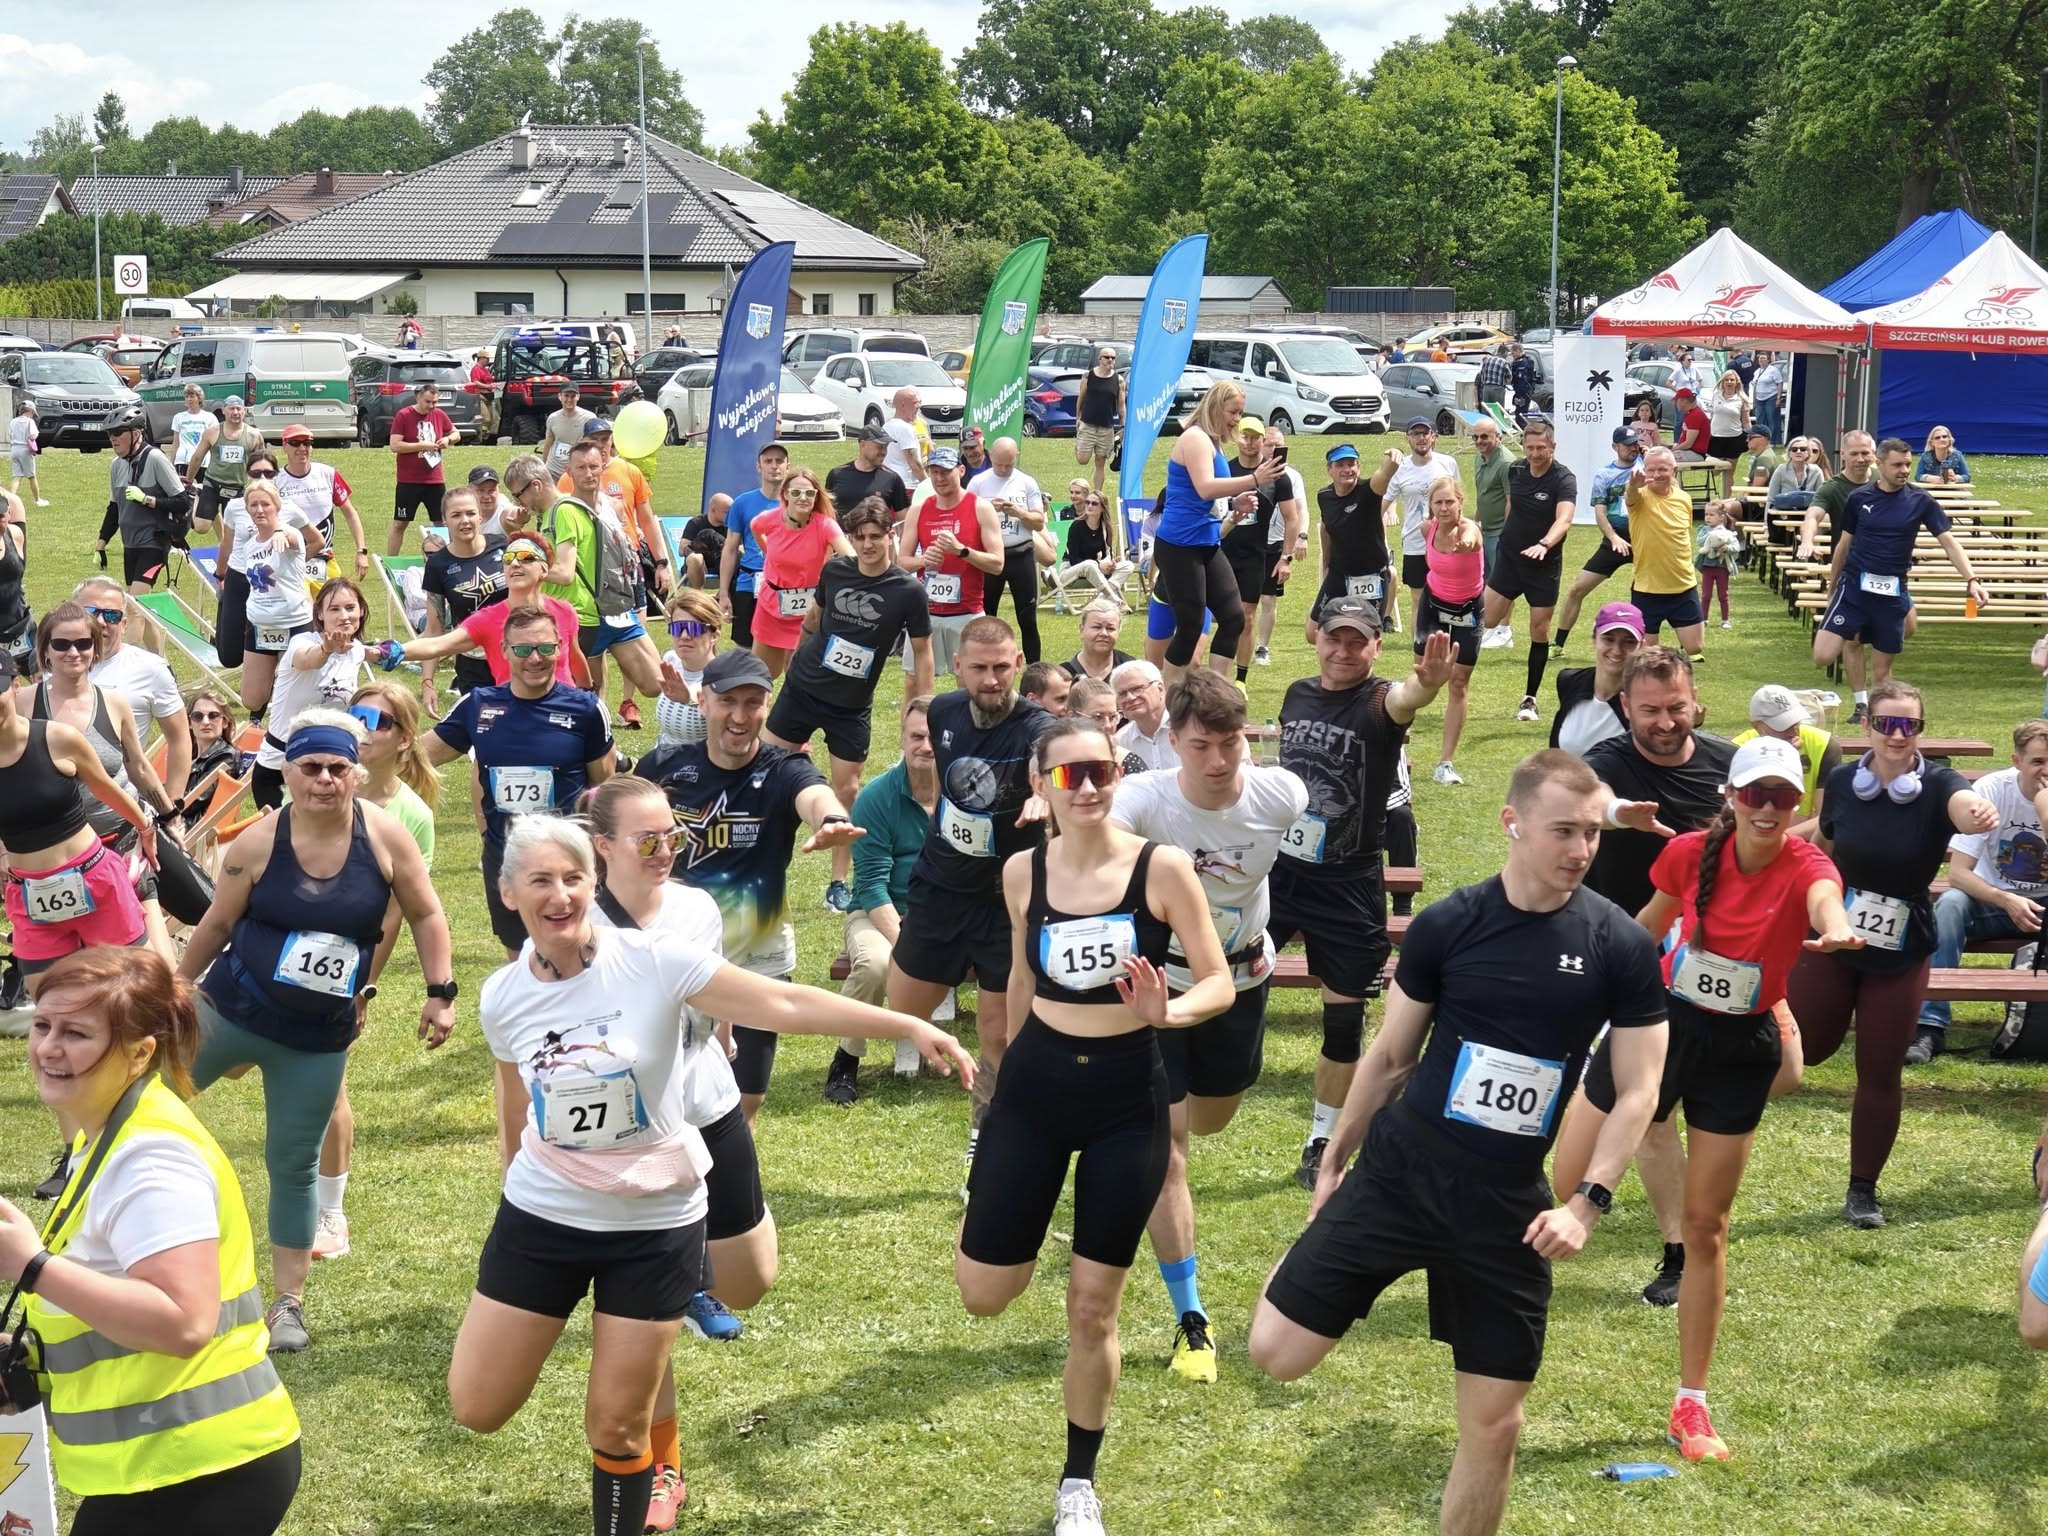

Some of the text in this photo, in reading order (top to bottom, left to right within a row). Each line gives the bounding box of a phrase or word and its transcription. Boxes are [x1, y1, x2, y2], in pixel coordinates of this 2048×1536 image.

[123, 268, 139, 281] 30
[1888, 330, 1969, 343] SZCZECIŃSKI
[1972, 335, 2005, 346] KLUB
[156, 388, 169, 399] STRAŻ
[263, 389, 300, 397] GRANICZNA
[972, 376, 1024, 423] Wyjątkowe
[718, 381, 777, 429] Wyjątkowe
[989, 391, 1022, 432] miejsce!
[1564, 401, 1597, 412] FIZJO
[736, 395, 776, 438] miejsce!
[1565, 413, 1599, 425] wyspa
[931, 584, 953, 596] 209
[1353, 583, 1375, 595] 120
[1869, 581, 1891, 590] 129
[791, 598, 807, 610] 22
[831, 611, 880, 631] canterbury
[263, 634, 284, 643] 136
[833, 651, 863, 670] 223
[504, 784, 541, 802] 173
[732, 823, 760, 834] NOCNY
[952, 823, 973, 844] 88
[36, 890, 77, 913] 163
[1855, 910, 1896, 937] 121
[298, 951, 345, 980] 163
[1062, 943, 1117, 974] 155
[1697, 973, 1731, 999] 88
[1476, 1078, 1538, 1116] 180
[568, 1102, 608, 1133] 27
